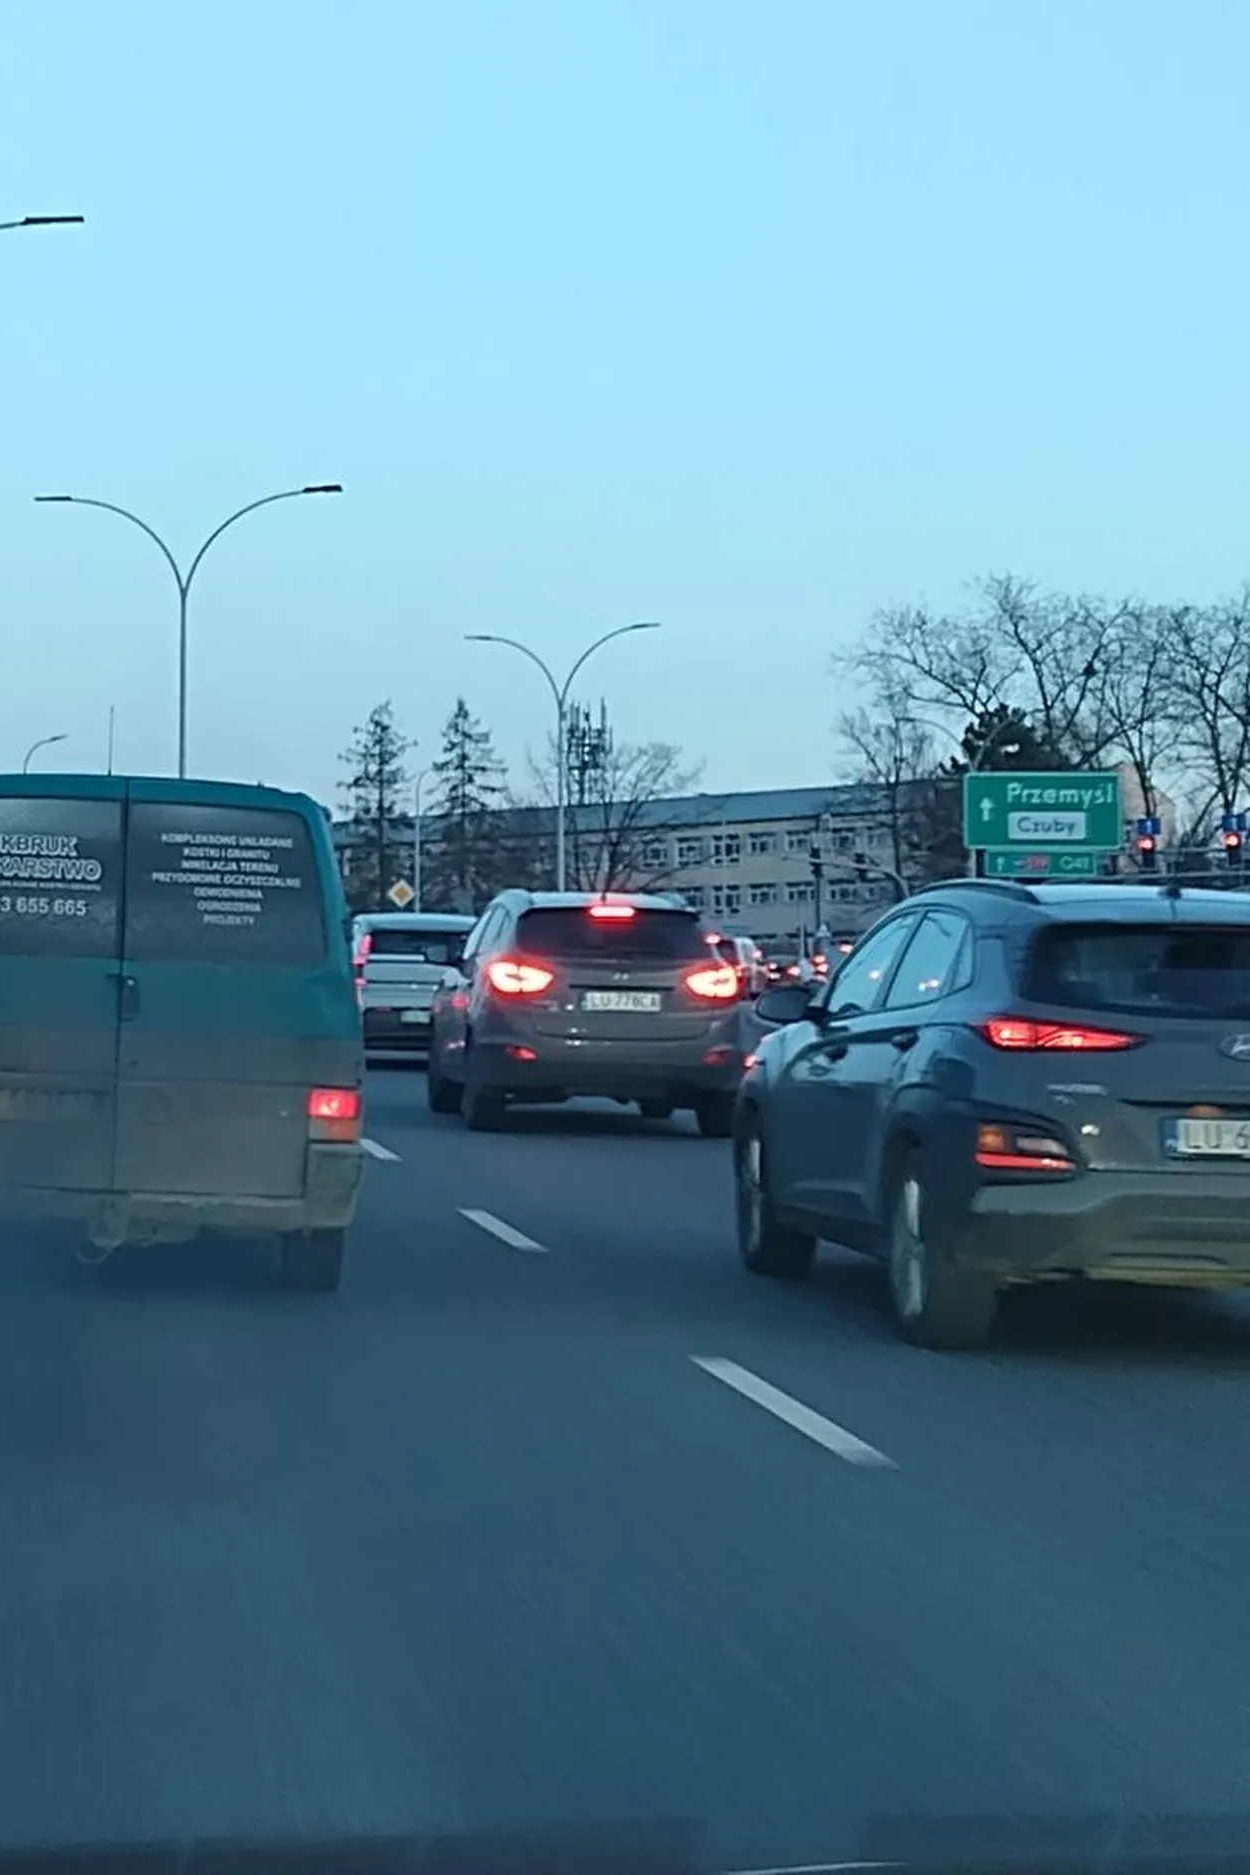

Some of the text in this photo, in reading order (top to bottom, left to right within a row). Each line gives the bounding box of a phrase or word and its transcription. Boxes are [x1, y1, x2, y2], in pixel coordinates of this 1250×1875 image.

[1006, 782, 1115, 810] Przemyśl
[1017, 817, 1076, 835] Czuby
[16, 897, 49, 914] 655
[53, 899, 87, 916] 665
[1185, 1123, 1222, 1150] LU
